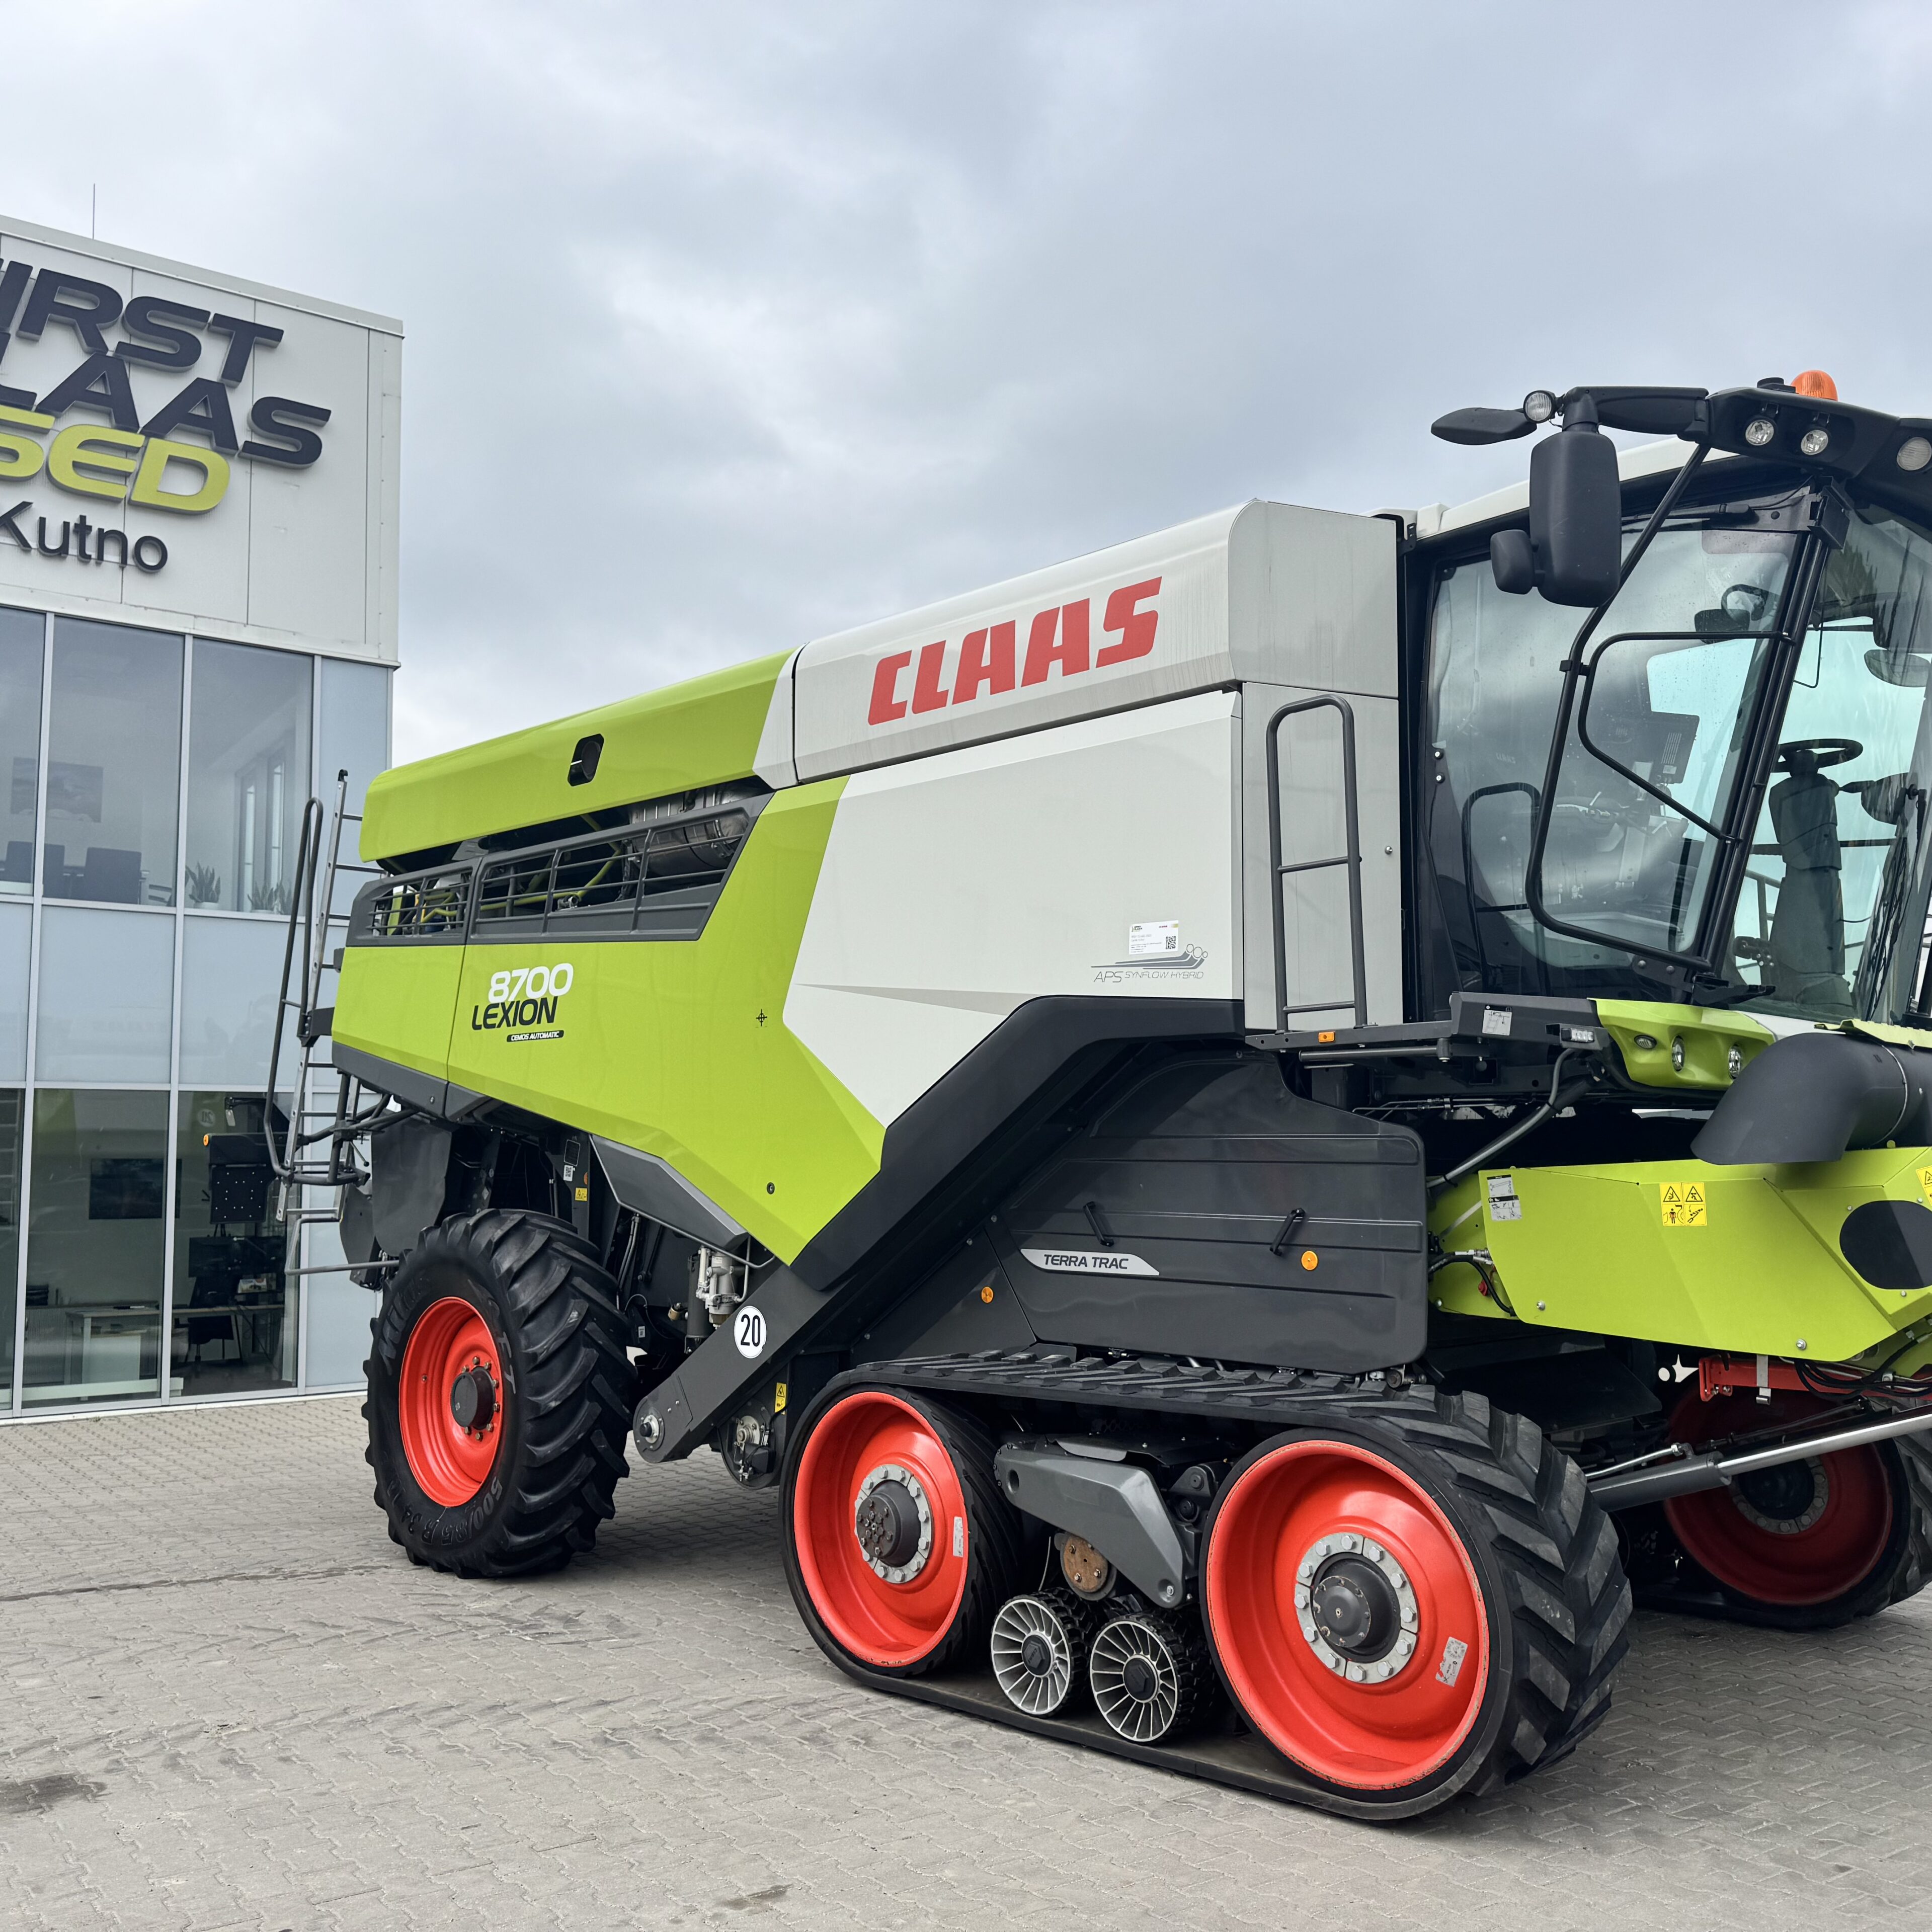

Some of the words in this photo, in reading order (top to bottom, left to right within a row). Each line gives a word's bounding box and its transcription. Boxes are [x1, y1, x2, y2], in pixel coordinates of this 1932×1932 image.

[0, 258, 284, 385] IRST
[0, 501, 168, 572] Kutno
[867, 576, 1163, 726] CLAAS
[489, 962, 574, 1004] 8700
[1093, 971, 1124, 983] APS
[472, 996, 558, 1030] LEXION
[529, 1031, 560, 1040] AUTOMATIC
[1044, 1254, 1088, 1267] TERRA
[1091, 1257, 1129, 1269] TRAC
[741, 1314, 760, 1347] 20
[441, 1476, 503, 1546] 500/85
